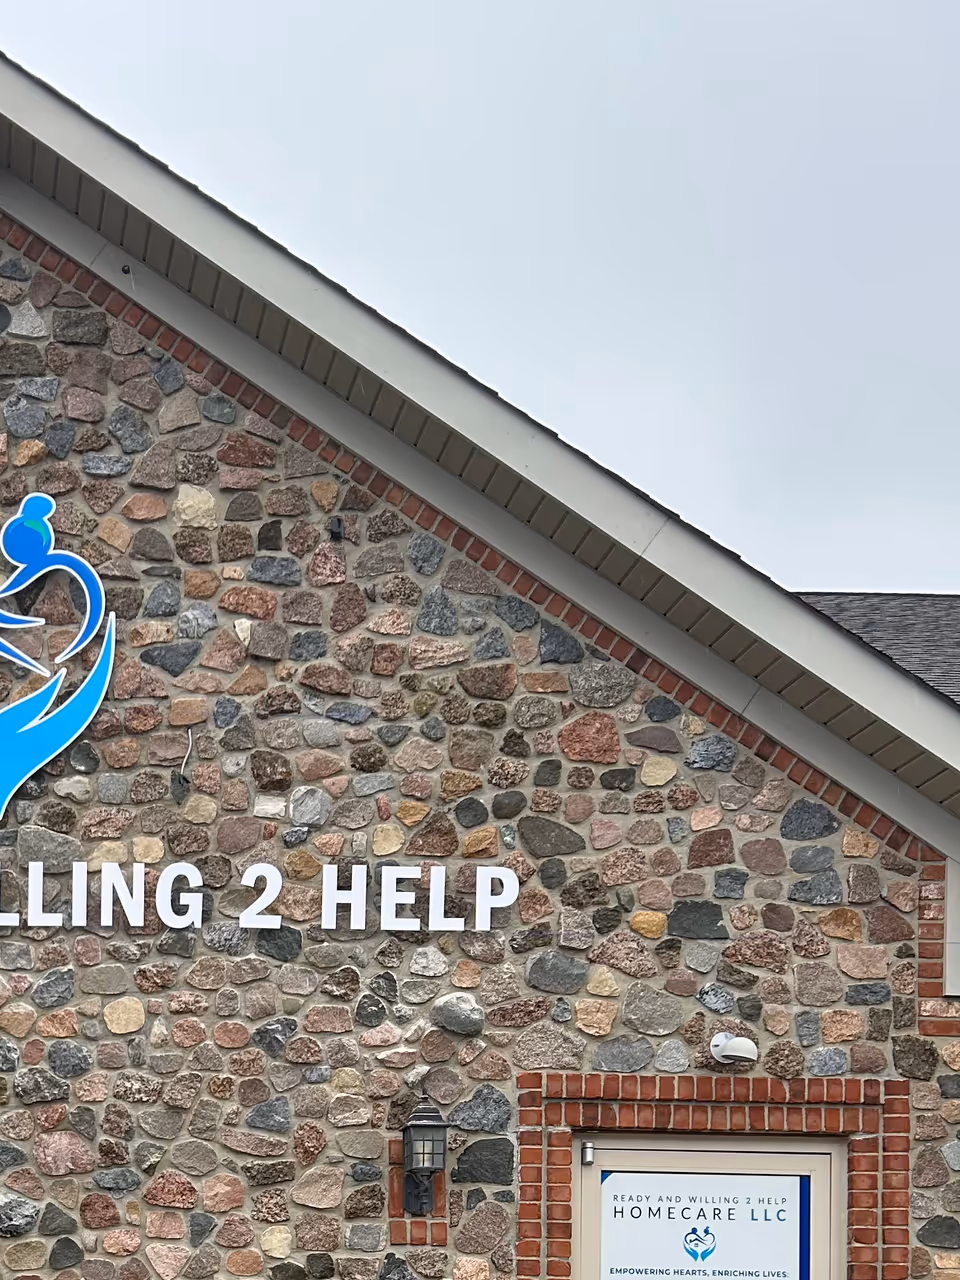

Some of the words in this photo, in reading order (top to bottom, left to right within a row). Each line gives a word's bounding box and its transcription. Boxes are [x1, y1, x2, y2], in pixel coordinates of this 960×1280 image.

[240, 862, 283, 930] 2
[321, 864, 521, 932] HELP
[613, 1194, 651, 1203] READY
[657, 1195, 682, 1204] AND
[688, 1196, 740, 1205] WILLING
[746, 1197, 752, 1205] 2
[758, 1197, 787, 1206] HELP
[613, 1206, 737, 1221] HOMECARE
[750, 1208, 787, 1222] LLC
[609, 1267, 671, 1276] EMPOWERING
[673, 1268, 710, 1277] HEARTS,
[712, 1269, 761, 1278] ENRICHING
